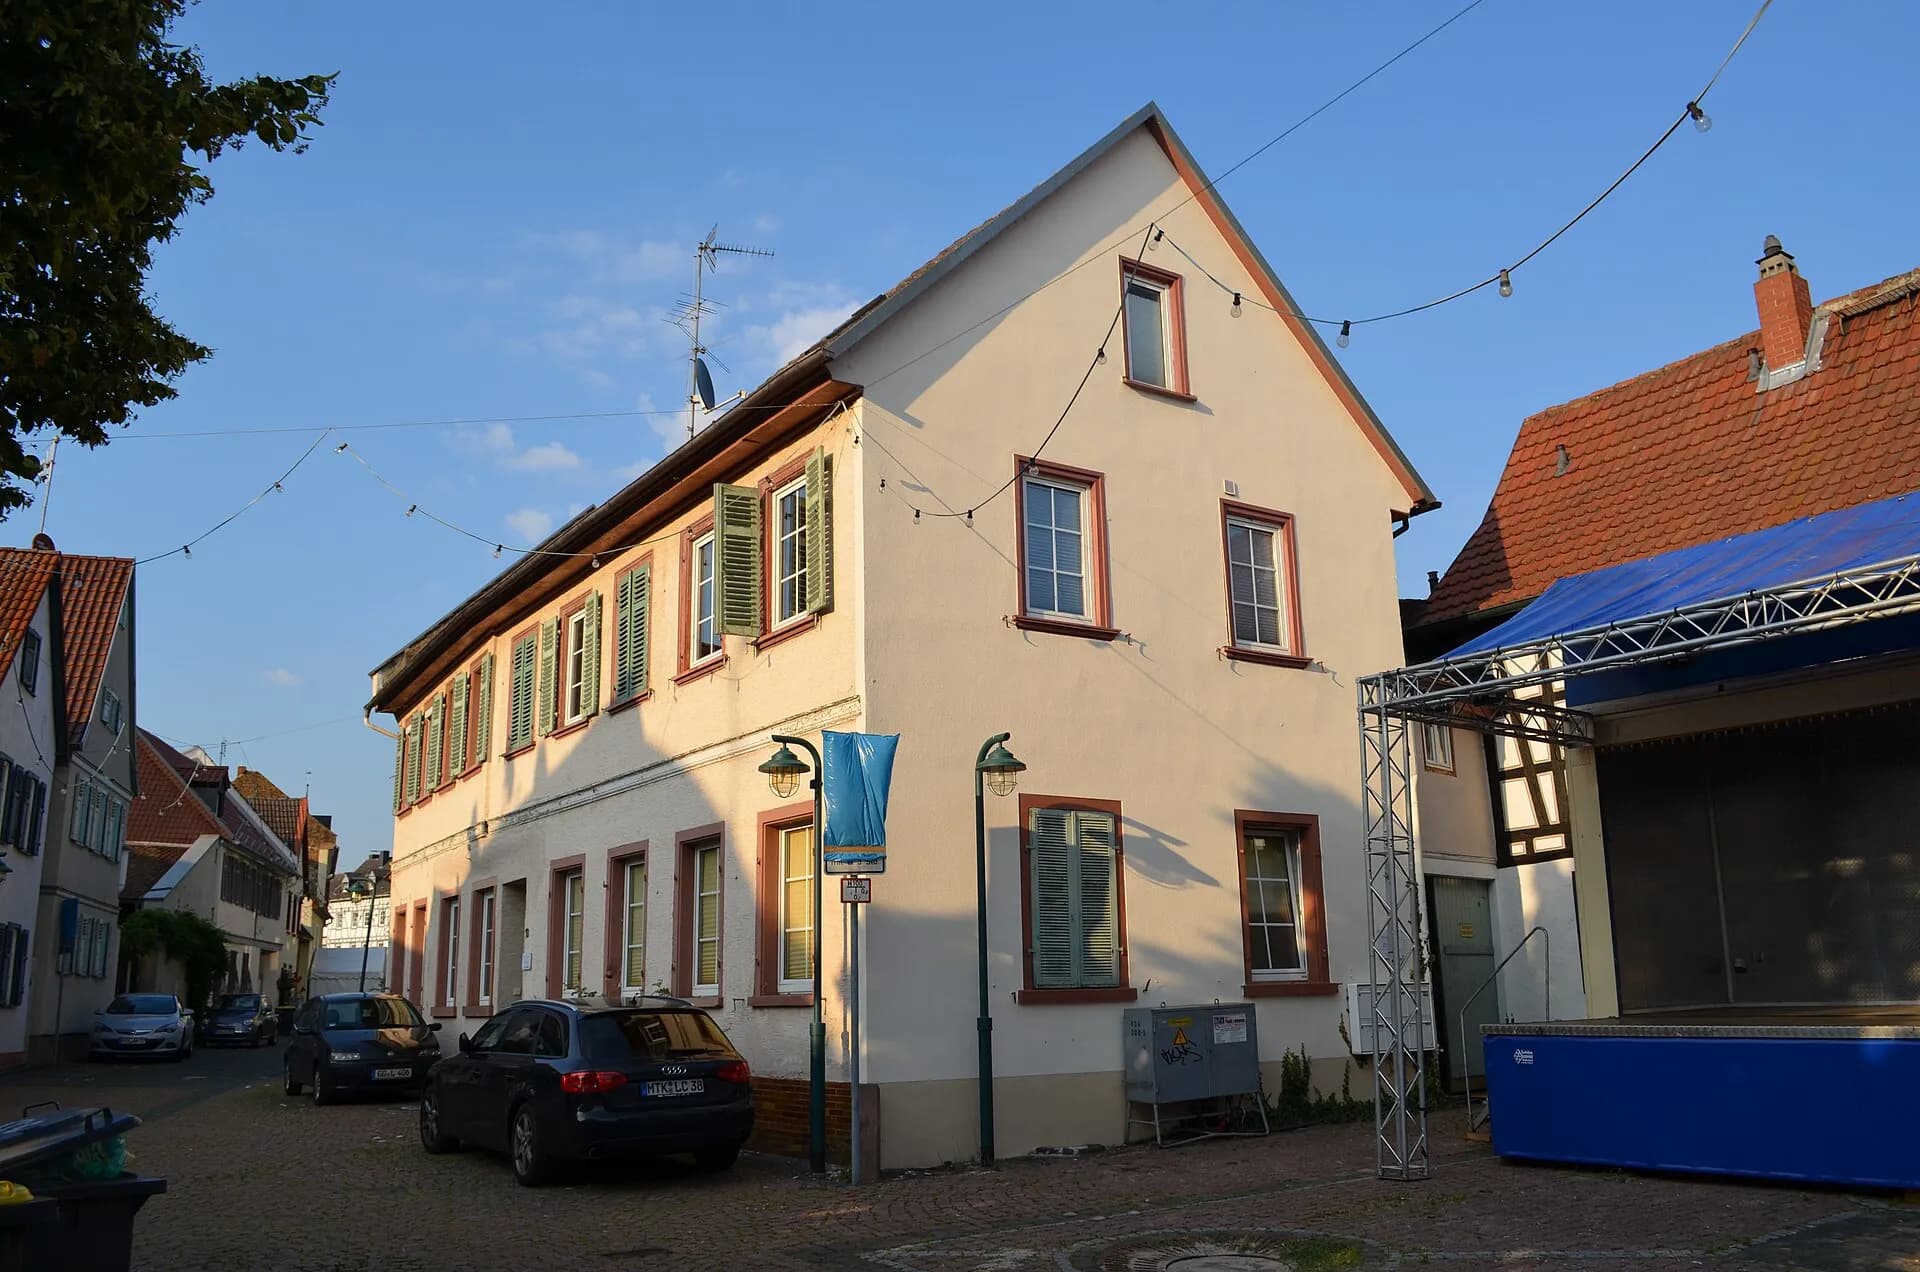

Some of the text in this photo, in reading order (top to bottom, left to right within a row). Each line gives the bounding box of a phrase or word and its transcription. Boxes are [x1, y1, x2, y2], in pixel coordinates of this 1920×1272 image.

[647, 1079, 703, 1093] MTK LC 38
